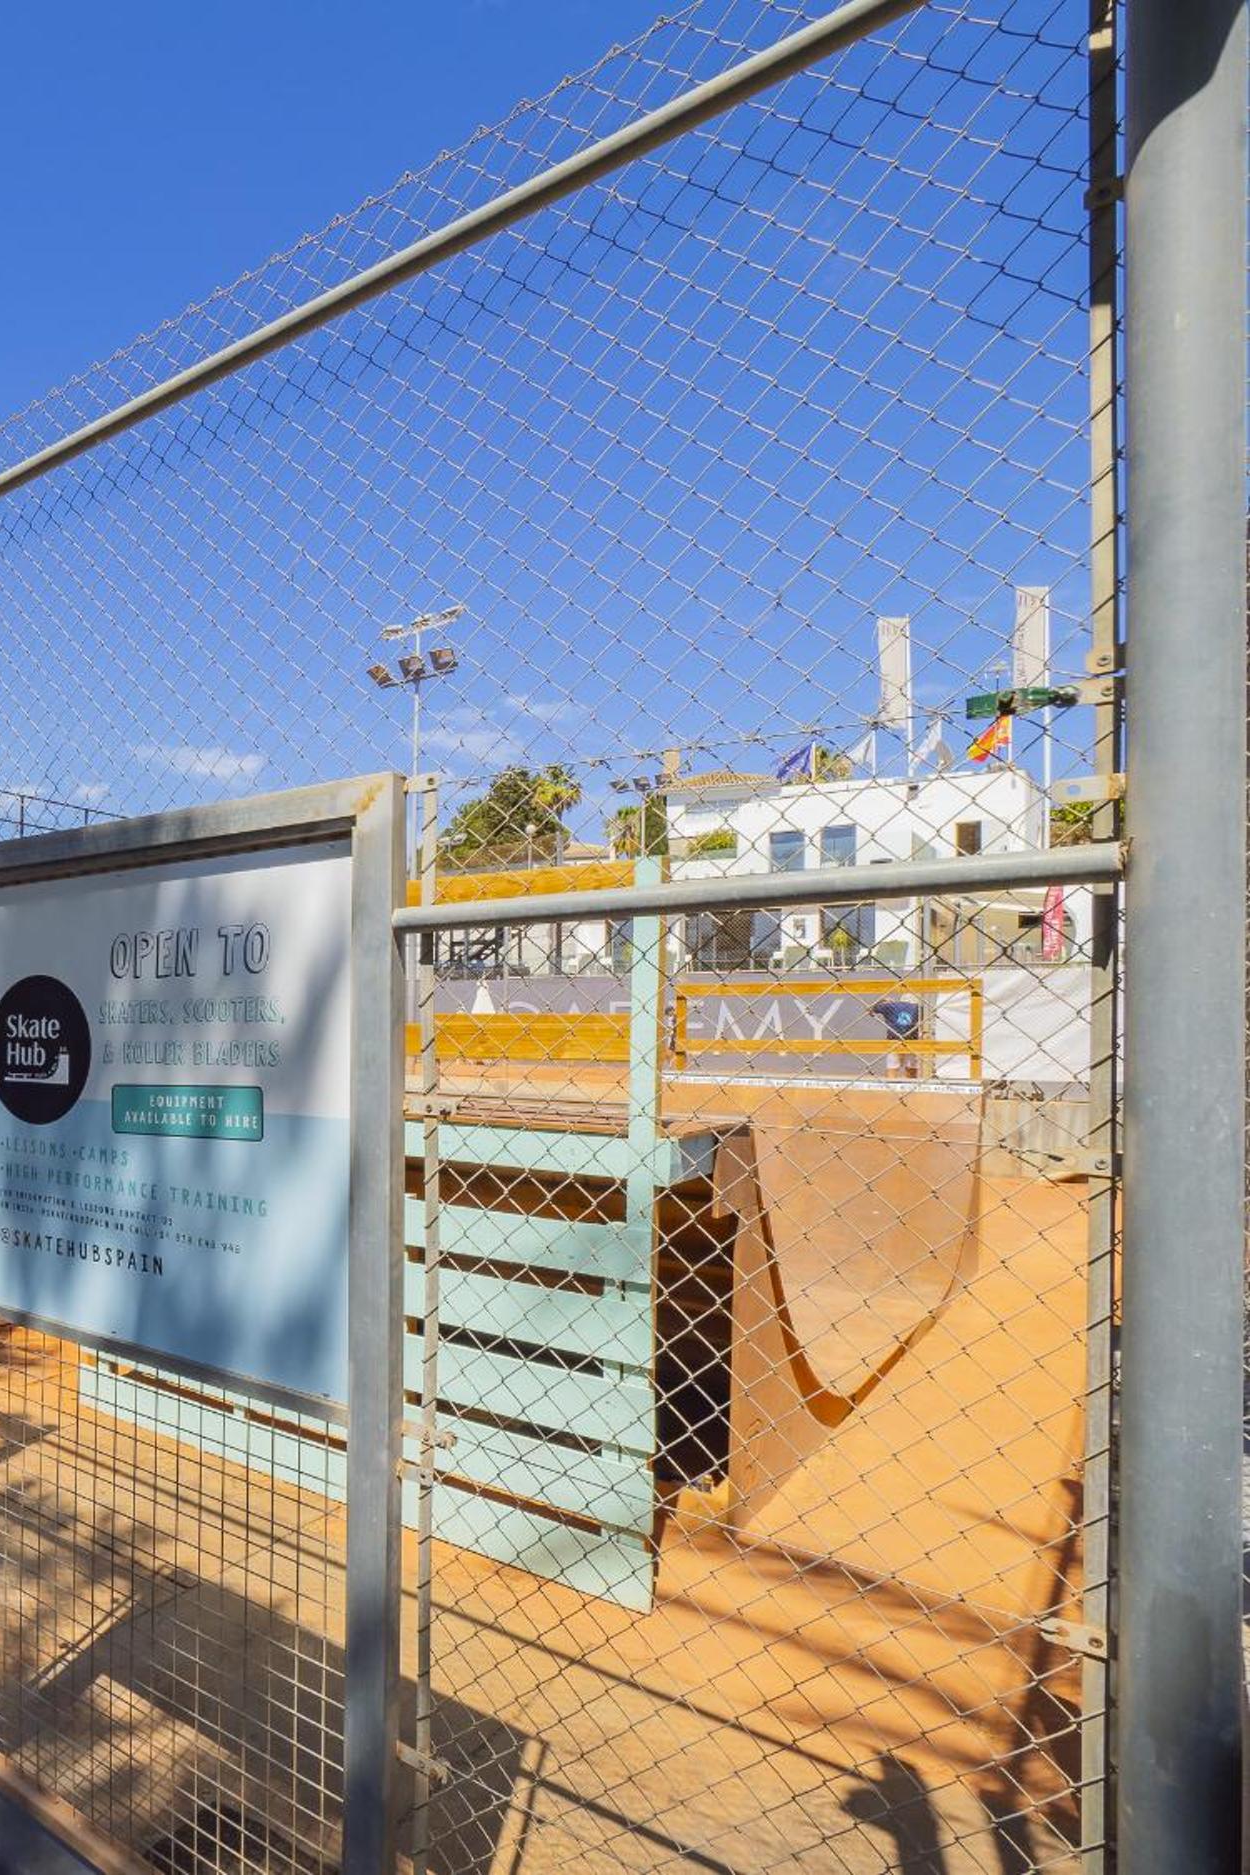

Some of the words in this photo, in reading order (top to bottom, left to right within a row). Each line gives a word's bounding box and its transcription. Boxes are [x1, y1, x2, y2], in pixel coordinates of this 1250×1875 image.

[110, 927, 200, 980] OPEN
[218, 922, 271, 976] TO
[182, 997, 286, 1025] SCOOTERS,
[6, 1013, 61, 1041] Skate
[6, 1041, 47, 1067] Hub
[122, 1039, 184, 1066] ROLLER
[192, 1039, 282, 1068] BLADERS
[149, 1094, 225, 1110] EQUIPMENT
[124, 1110, 193, 1127] AVAILABLE
[200, 1113, 217, 1127] TO
[224, 1115, 259, 1130] HIRE
[47, 1166, 158, 1202] PERFORMANCE
[169, 1185, 269, 1218] TRAINING
[0, 1228, 163, 1276] @SKATEHUBSPAIN
